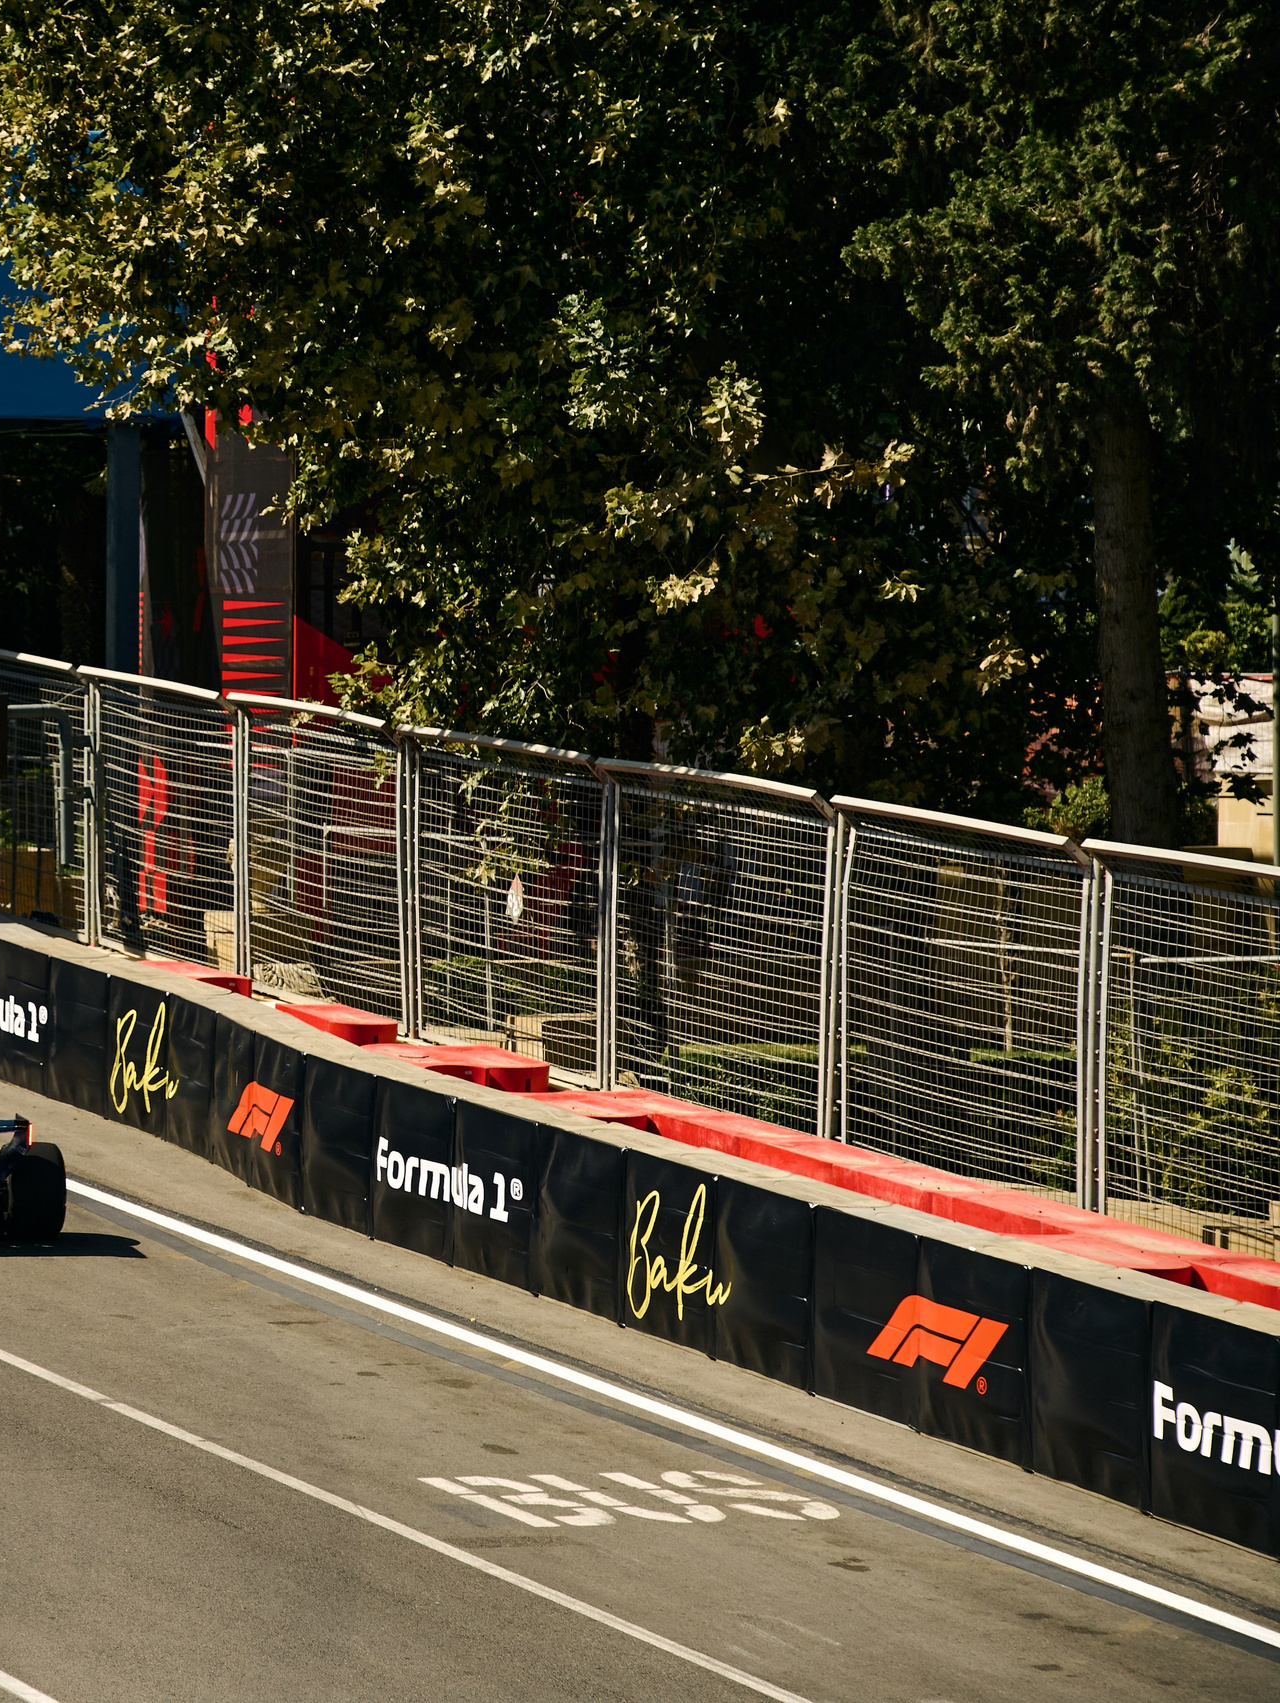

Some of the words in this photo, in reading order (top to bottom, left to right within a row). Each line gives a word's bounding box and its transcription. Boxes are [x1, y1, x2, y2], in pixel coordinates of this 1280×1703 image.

[109, 1001, 181, 1114] Baku
[375, 1135, 485, 1216] Formula
[626, 1182, 733, 1322] Baku
[1152, 1380, 1280, 1477] Form
[416, 1469, 841, 1528] BUS
